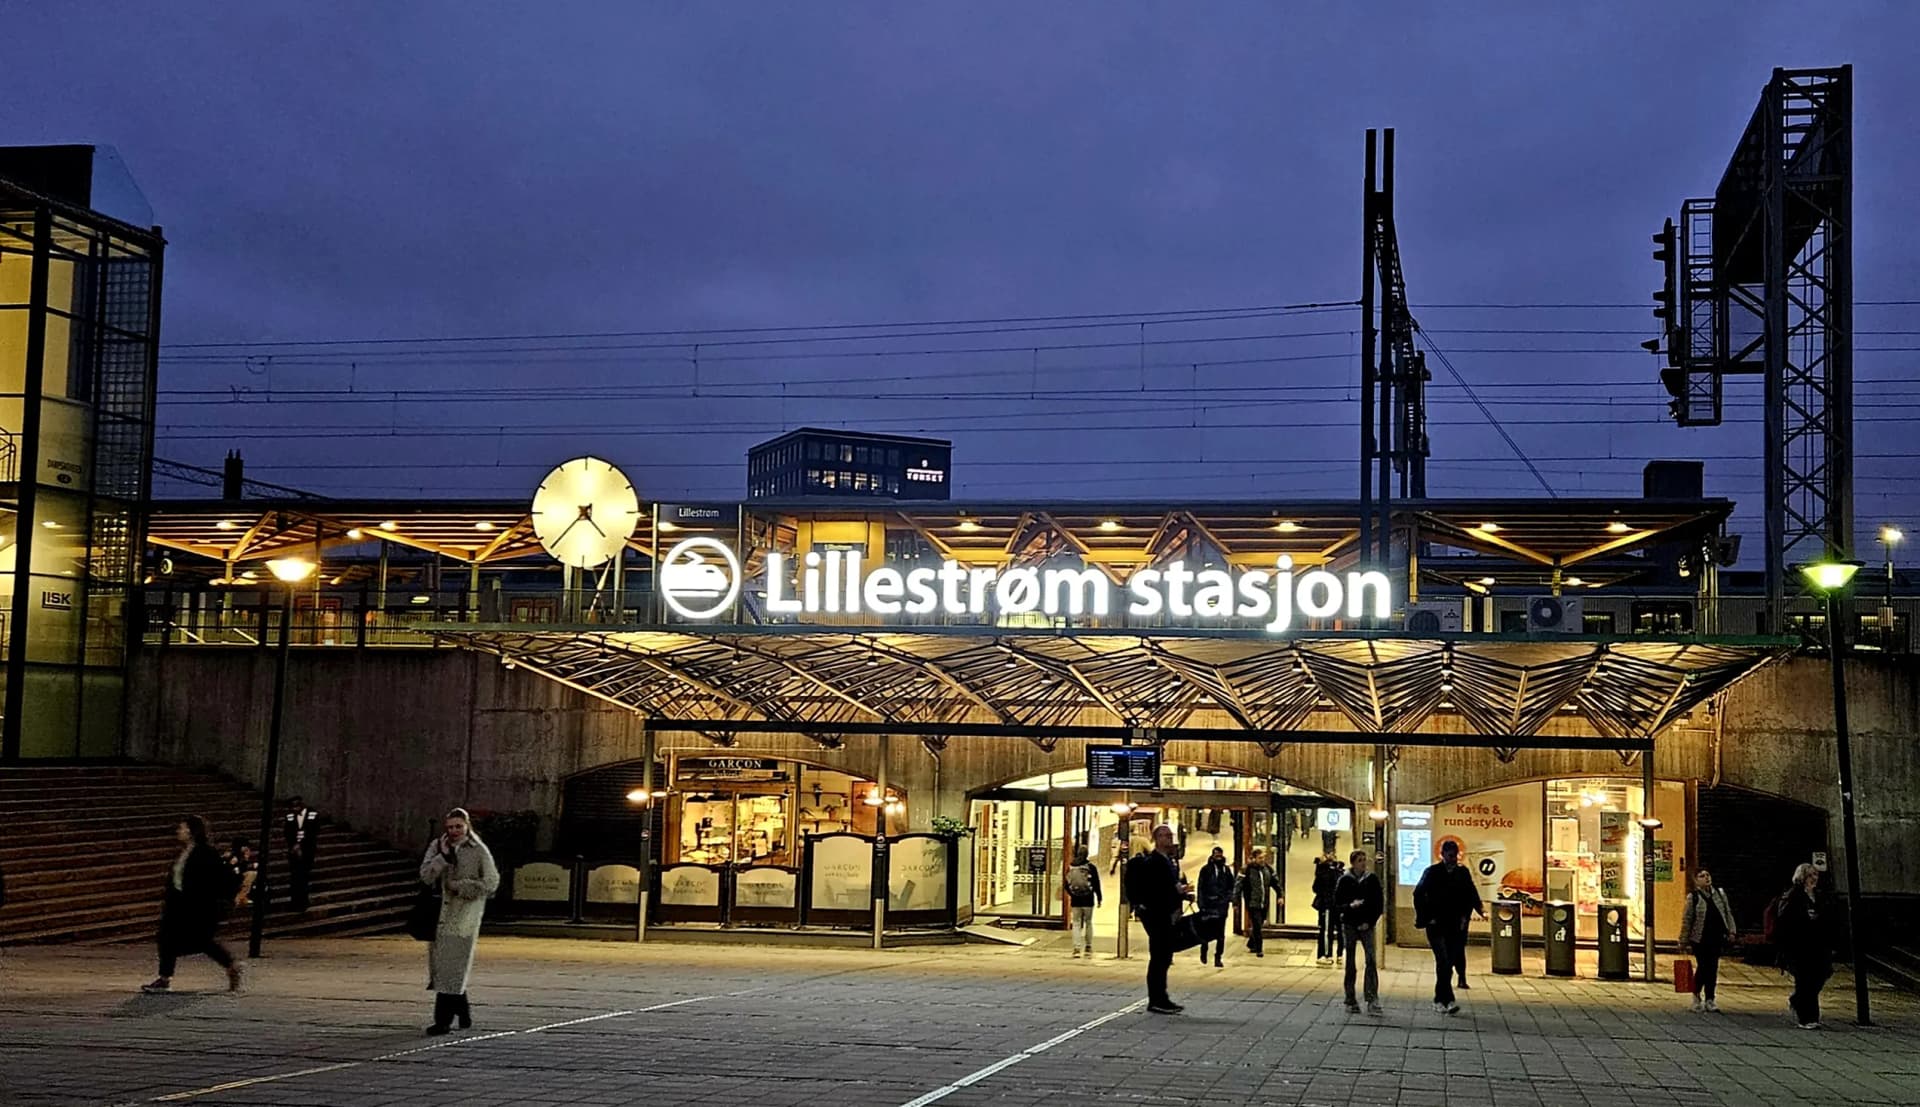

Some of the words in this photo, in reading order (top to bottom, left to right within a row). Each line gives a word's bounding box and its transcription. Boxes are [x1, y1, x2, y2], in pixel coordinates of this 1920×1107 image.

[679, 507, 720, 518] Lillestrøm
[765, 549, 1111, 616] Lillestrøm
[1128, 553, 1393, 634] stasjon
[1456, 803, 1489, 814] Kaffe
[1492, 804, 1502, 815] &
[1443, 817, 1514, 829] rundstykke
